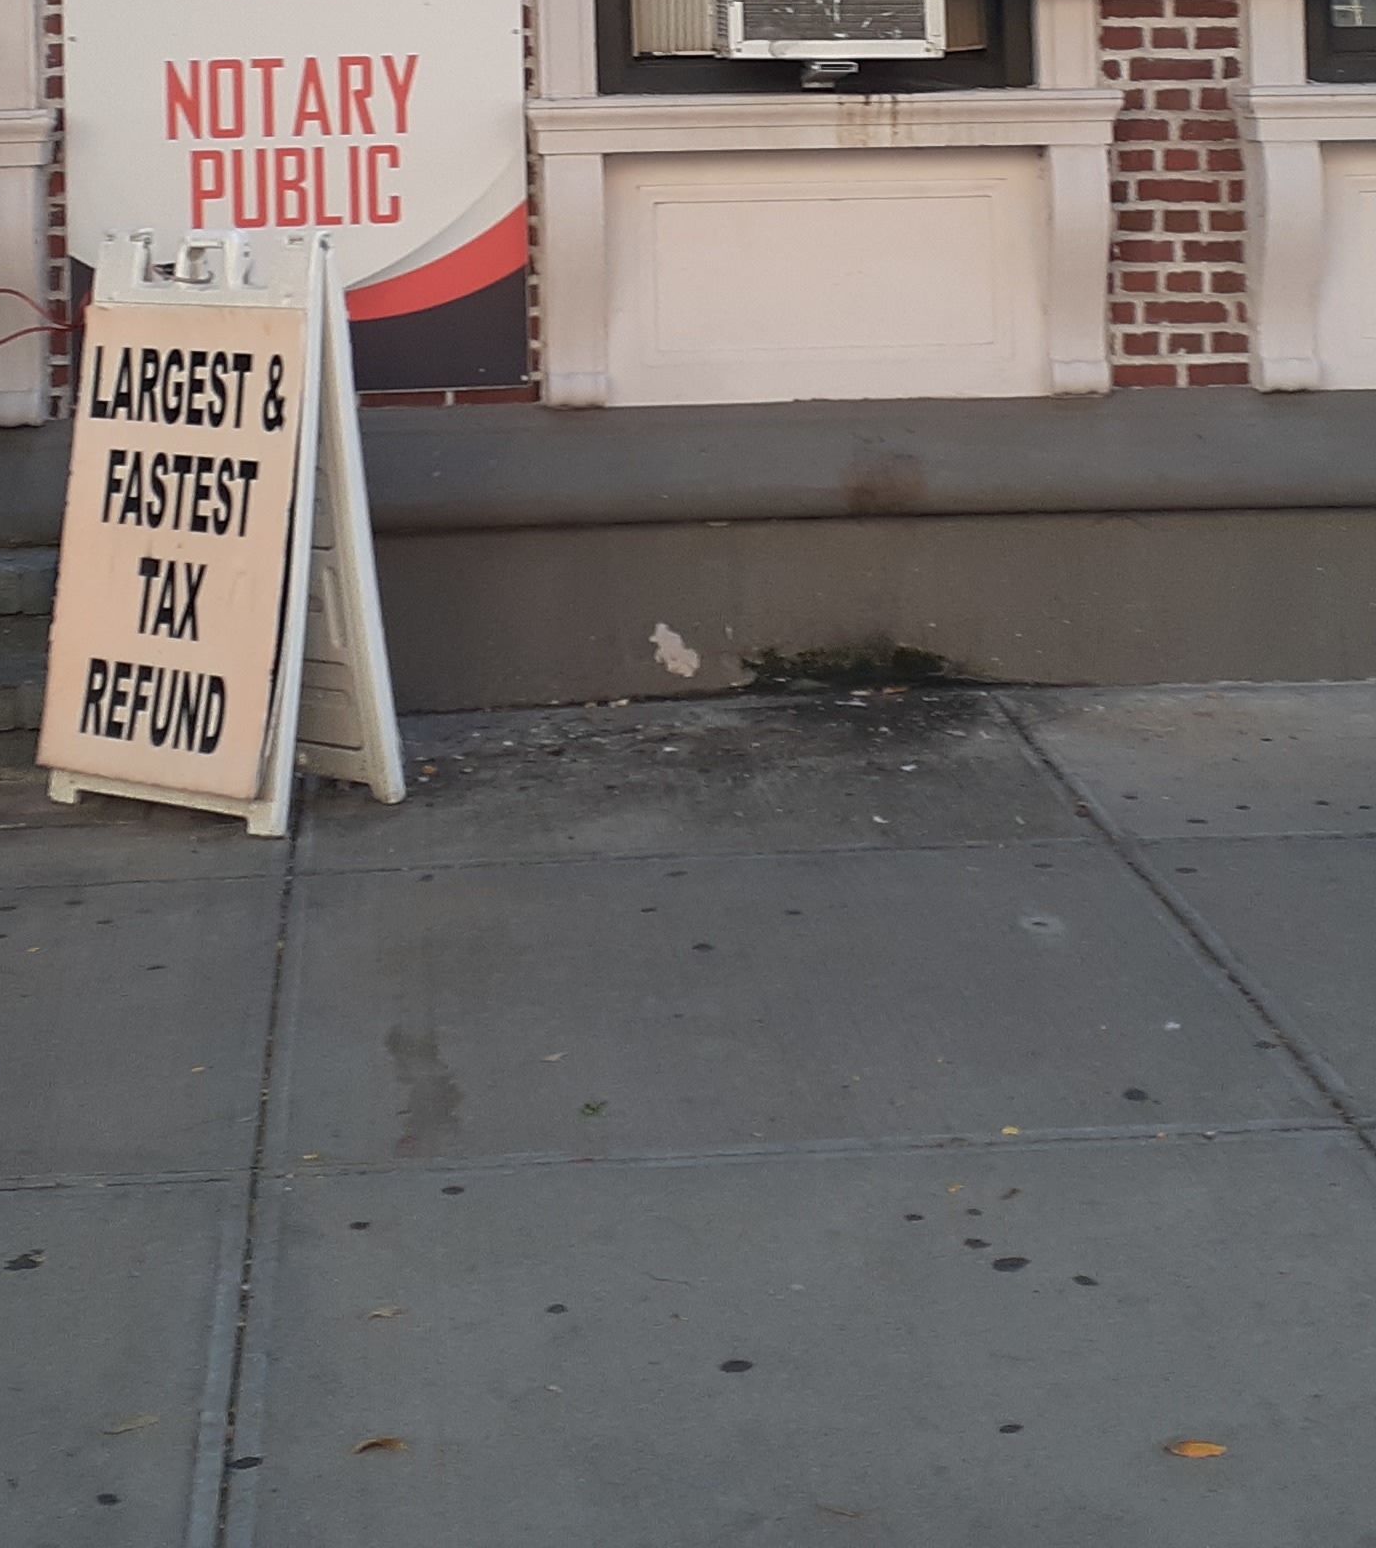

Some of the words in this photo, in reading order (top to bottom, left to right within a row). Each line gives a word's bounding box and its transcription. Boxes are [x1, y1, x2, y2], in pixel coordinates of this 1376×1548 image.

[167, 55, 417, 140] NOTARY
[191, 145, 400, 229] PUBLIC
[91, 346, 252, 428] LARGEST
[263, 355, 285, 431] &
[103, 450, 258, 537] FASTEST
[139, 557, 205, 641] TAX
[81, 658, 226, 754] REFUND
